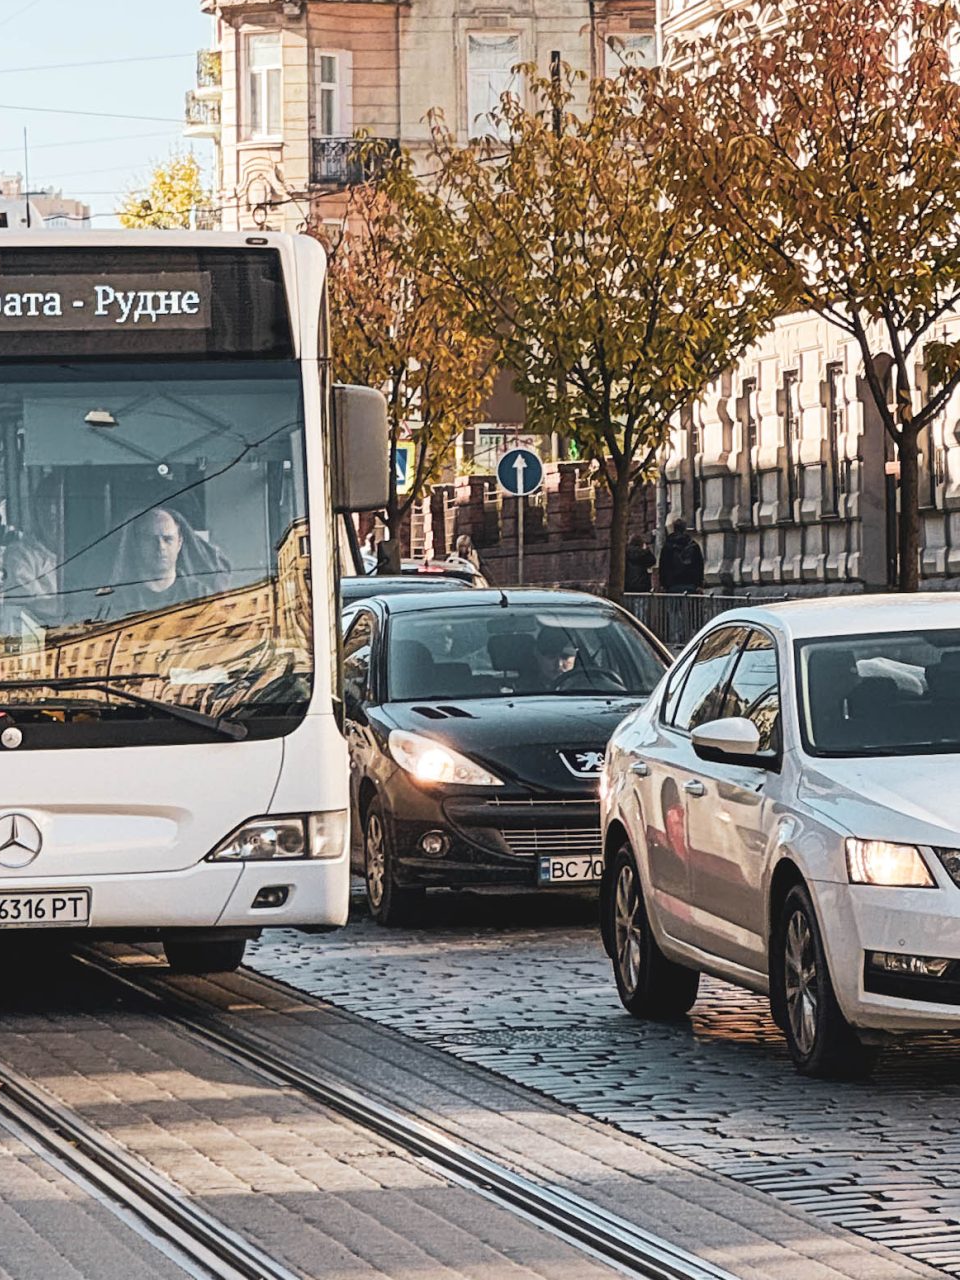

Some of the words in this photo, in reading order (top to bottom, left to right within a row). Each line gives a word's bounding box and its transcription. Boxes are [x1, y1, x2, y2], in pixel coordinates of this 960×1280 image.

[94, 285, 200, 323] Рудне
[552, 861, 578, 878] BC
[52, 897, 83, 919] PT
